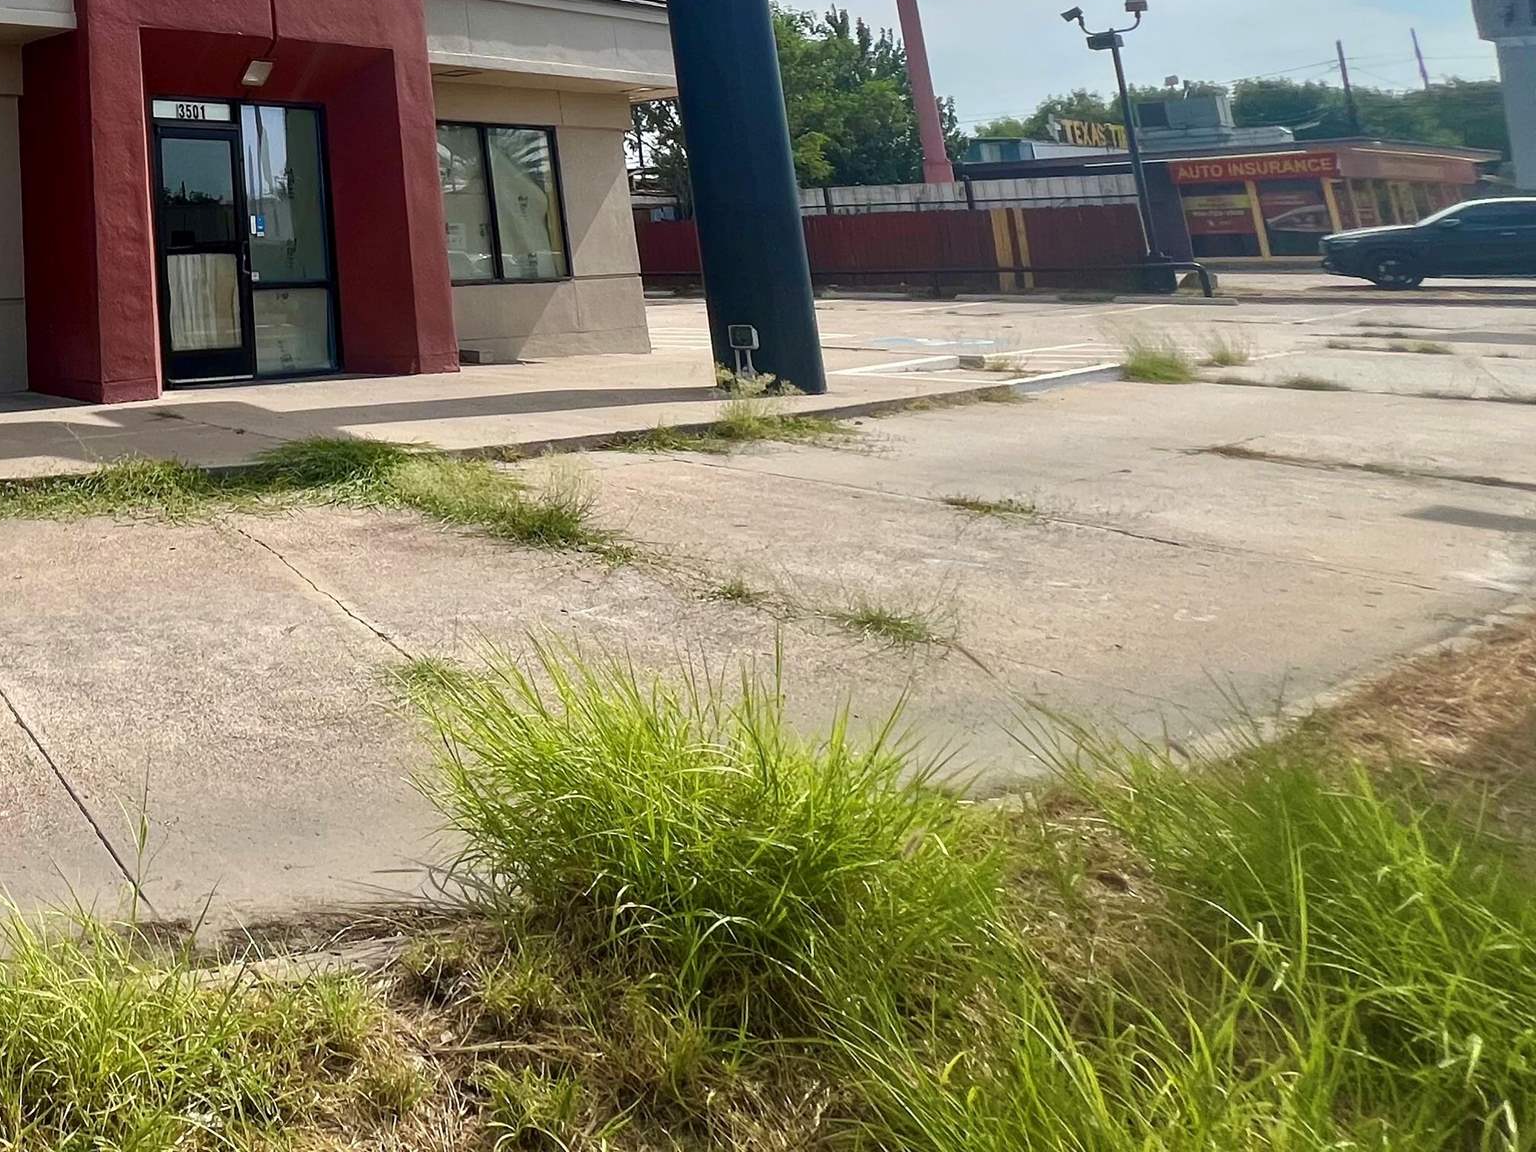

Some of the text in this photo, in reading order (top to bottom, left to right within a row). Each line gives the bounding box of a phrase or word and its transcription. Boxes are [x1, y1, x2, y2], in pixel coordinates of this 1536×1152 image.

[1061, 119, 1105, 147] TEXAS
[1177, 158, 1333, 179] AUTO INSURANCE
